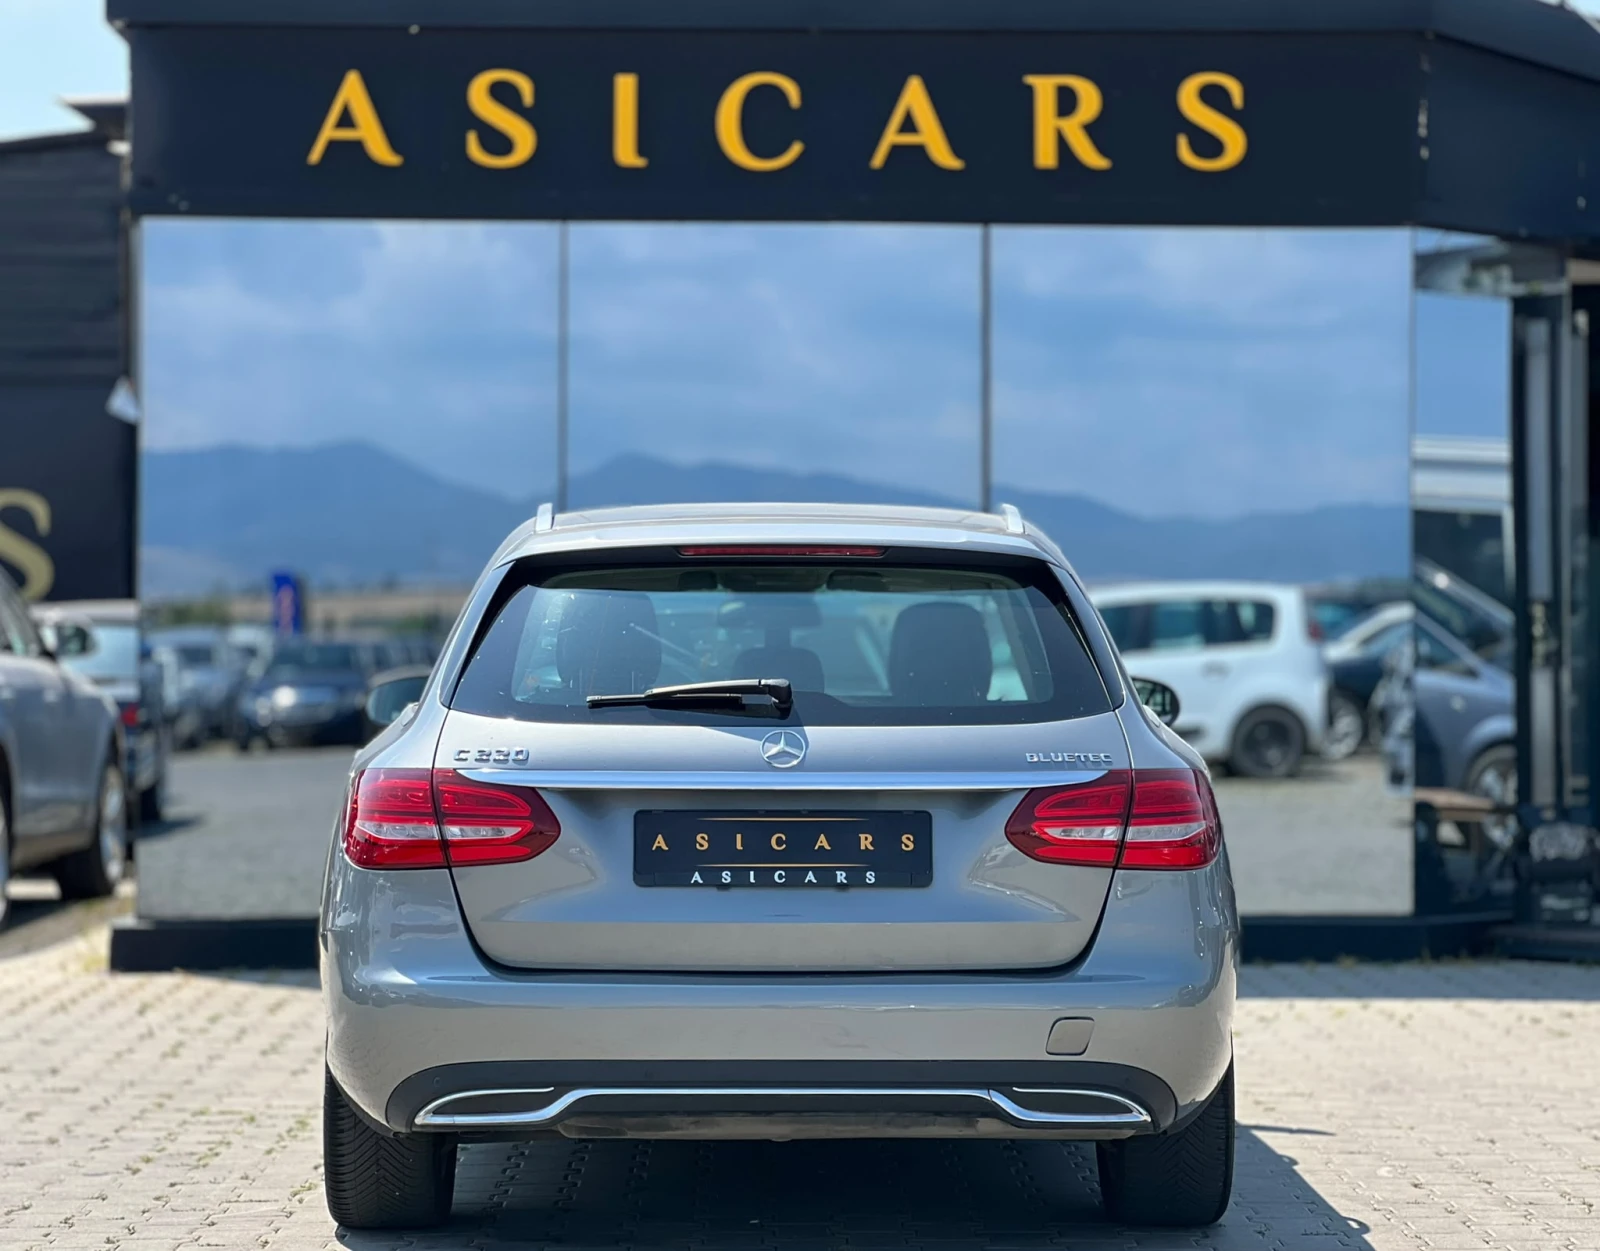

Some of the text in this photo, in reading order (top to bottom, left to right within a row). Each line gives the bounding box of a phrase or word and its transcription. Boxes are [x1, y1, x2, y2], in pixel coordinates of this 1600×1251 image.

[307, 69, 1248, 172] ASICARS
[453, 748, 529, 763] C 220
[1025, 752, 1112, 763] BLUETEC
[651, 833, 915, 851] ASICARS
[690, 870, 876, 884] ASICARS
